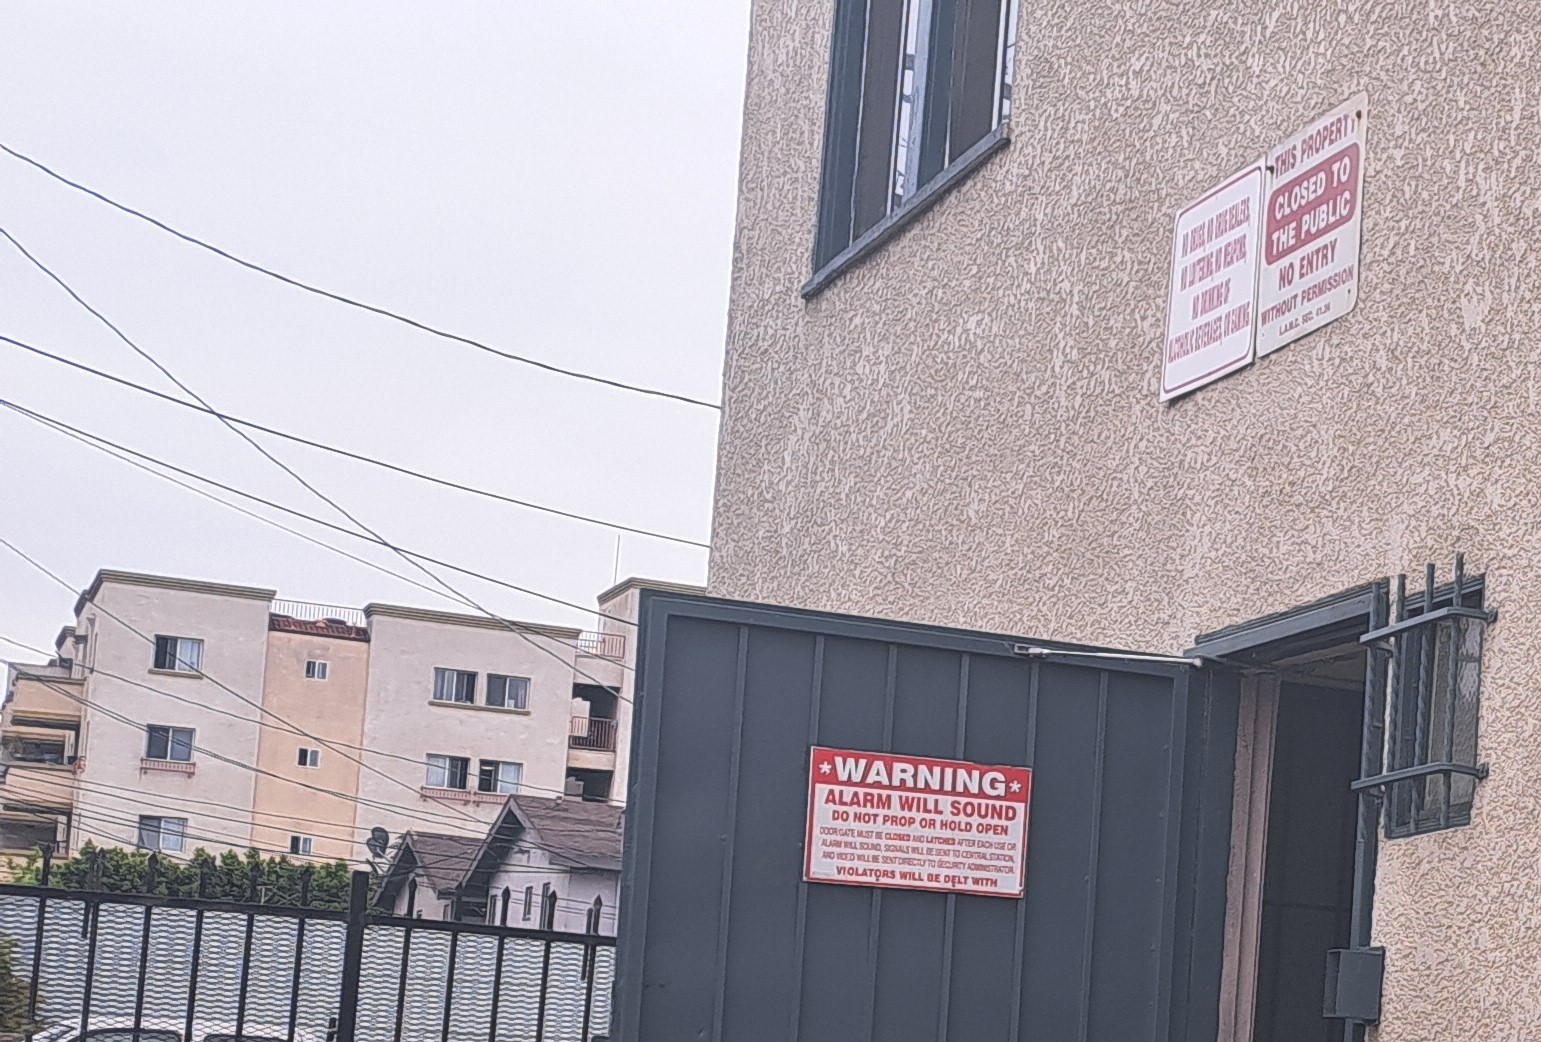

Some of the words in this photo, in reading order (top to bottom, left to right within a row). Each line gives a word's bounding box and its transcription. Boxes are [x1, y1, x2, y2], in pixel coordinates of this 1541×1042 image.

[1274, 144, 1296, 178] THIS
[1276, 172, 1325, 220] CLOSED
[1332, 156, 1350, 187] TO
[1272, 221, 1296, 255] THE
[1301, 191, 1350, 239] PUBLIC
[1279, 262, 1294, 290] NO
[1299, 238, 1337, 280] ENTRY
[1261, 294, 1298, 326] WITHOUT
[1301, 265, 1354, 306] PERMISSION
[833, 756, 1006, 797] WARNING
[824, 788, 891, 810] ALARM
[898, 795, 944, 815] WILL
[949, 799, 1016, 822] SOUND
[831, 809, 849, 821] DO
[853, 812, 878, 824] NOT
[881, 814, 915, 827] PROP
[919, 817, 935, 829] OR
[940, 820, 972, 832] HOLD
[975, 823, 1008, 836] OPEN
[884, 832, 910, 841] CLOSED
[926, 835, 955, 845] LATCHED
[835, 865, 896, 879] VIOLATORS
[898, 870, 924, 881] WILL
[926, 872, 941, 882] BE
[943, 874, 969, 885] DELT
[971, 876, 998, 887] WITH
